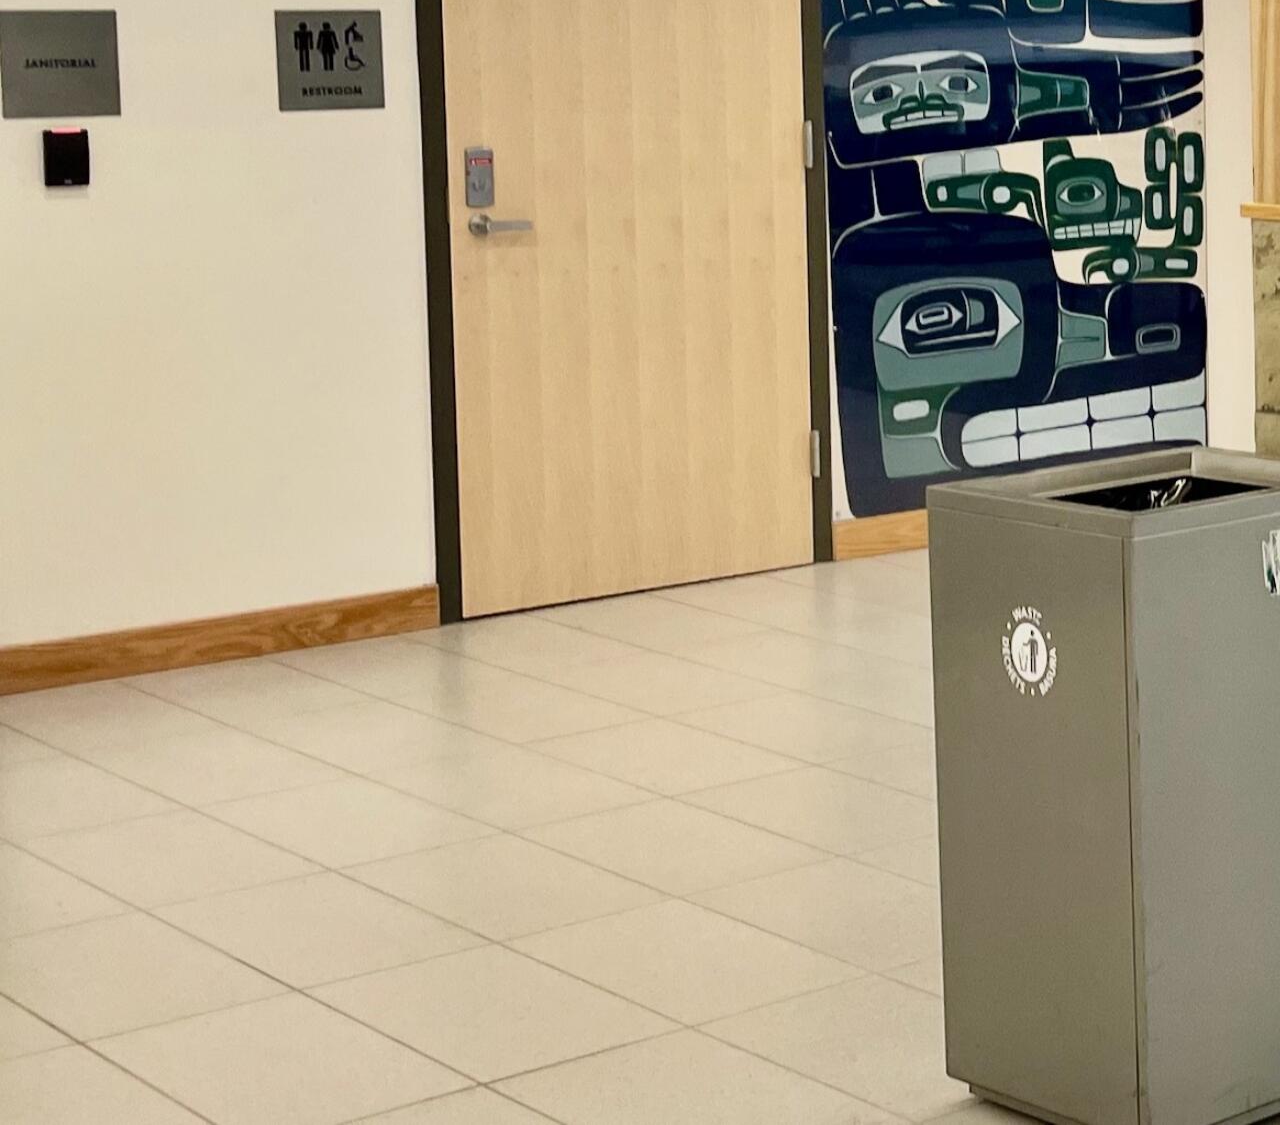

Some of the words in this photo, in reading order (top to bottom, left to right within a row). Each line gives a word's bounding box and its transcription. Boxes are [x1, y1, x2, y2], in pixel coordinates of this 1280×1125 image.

[24, 58, 97, 69] JANITORIAL
[302, 85, 363, 96] RESTROOM
[1012, 606, 1042, 626] WASTE
[1039, 647, 1057, 696] BASURA
